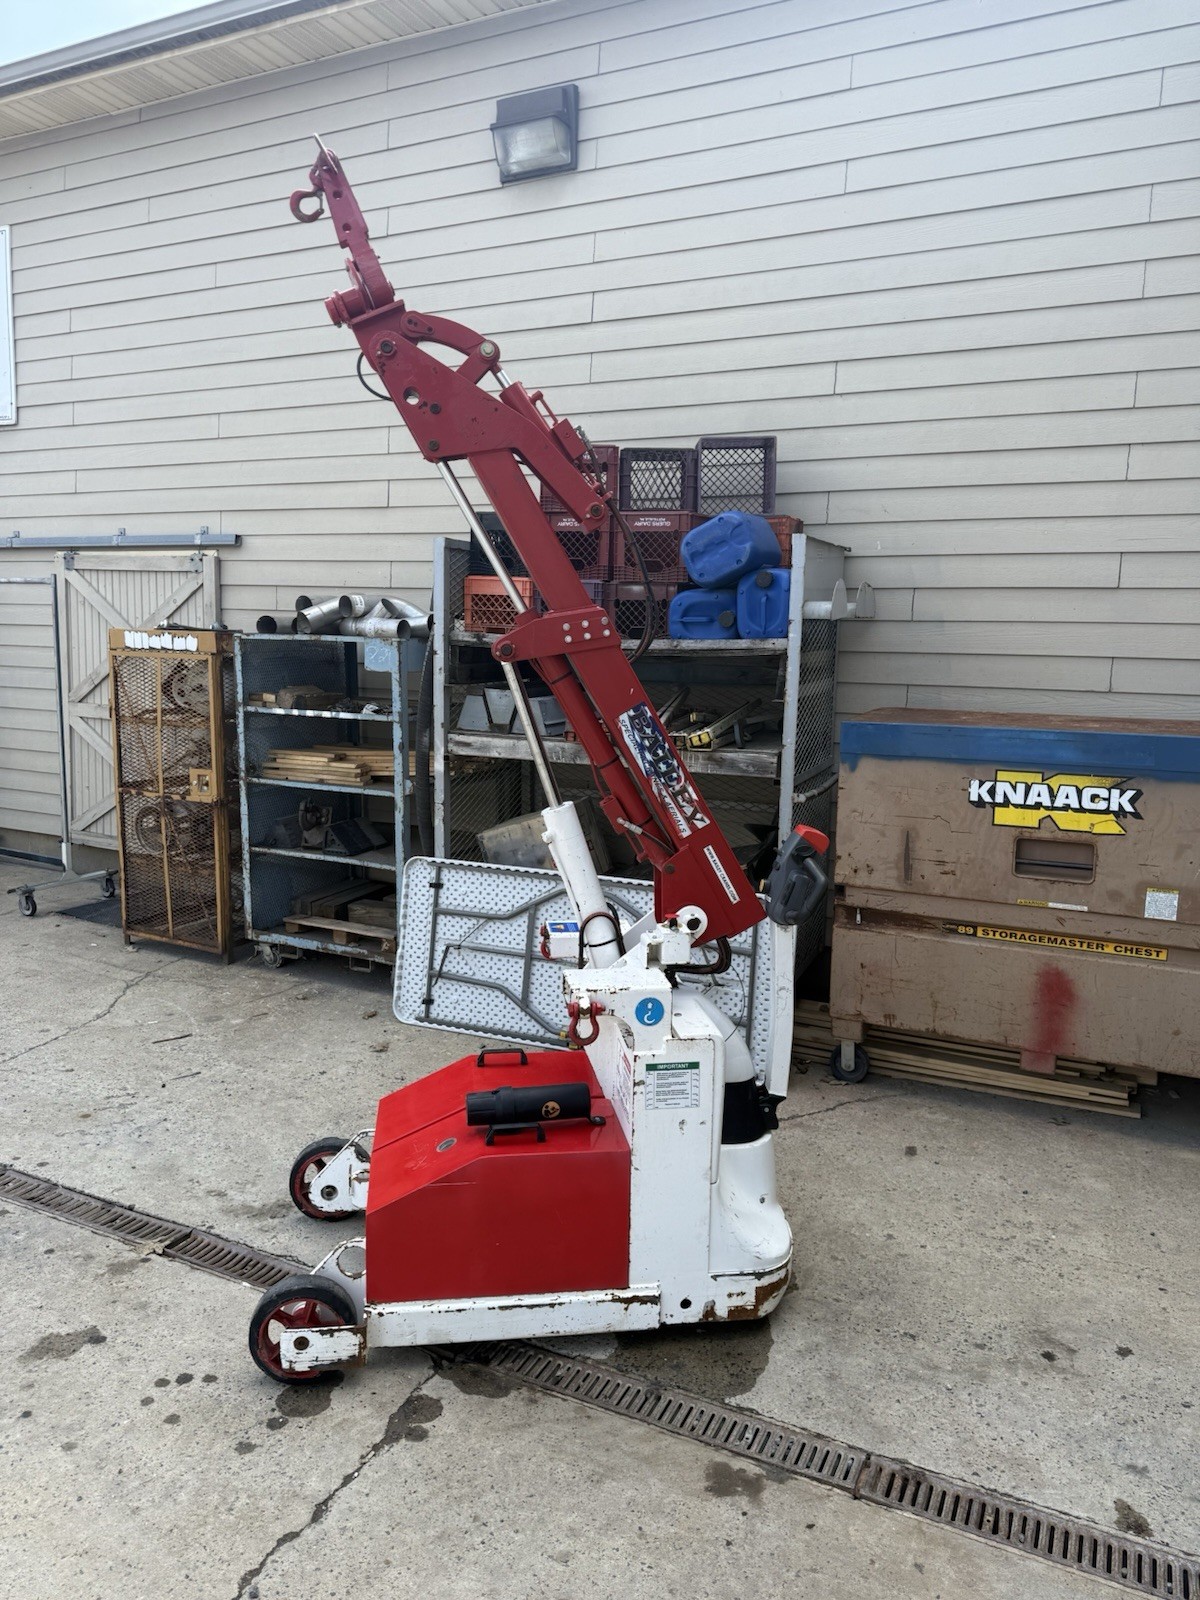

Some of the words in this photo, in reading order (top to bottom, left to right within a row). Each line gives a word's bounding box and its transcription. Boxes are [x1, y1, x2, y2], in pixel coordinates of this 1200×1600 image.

[968, 779, 1141, 816] KNAACK
[957, 925, 974, 934] 89
[1113, 944, 1164, 959] CHEST
